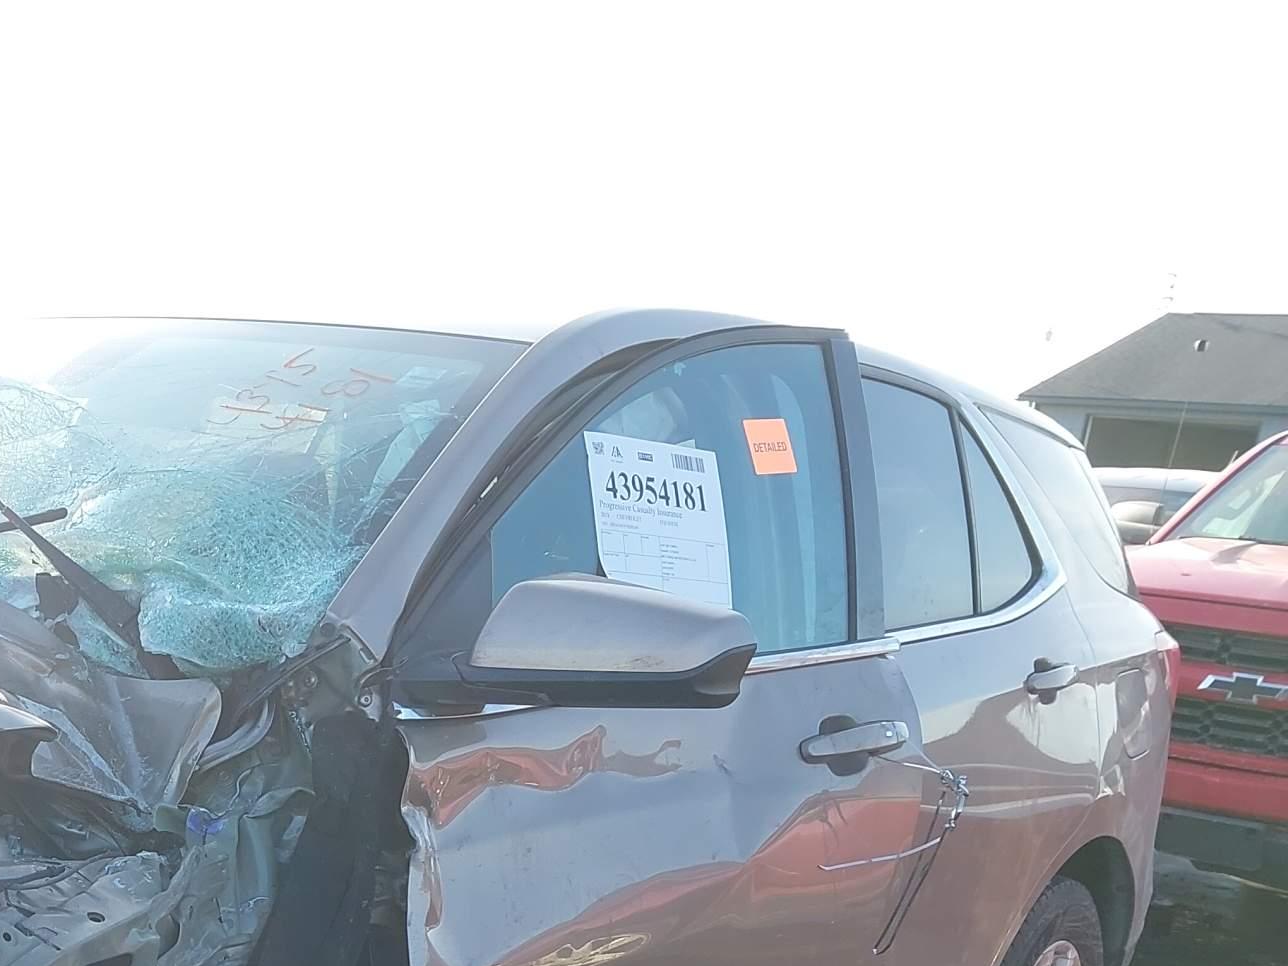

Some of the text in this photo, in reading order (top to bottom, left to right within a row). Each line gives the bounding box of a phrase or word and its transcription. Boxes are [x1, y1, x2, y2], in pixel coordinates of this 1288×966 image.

[753, 441, 788, 453] DETAILED
[605, 471, 709, 512] 43954181
[599, 500, 632, 512] Progressive
[632, 504, 656, 517] Casualty
[657, 508, 682, 519] Insurance
